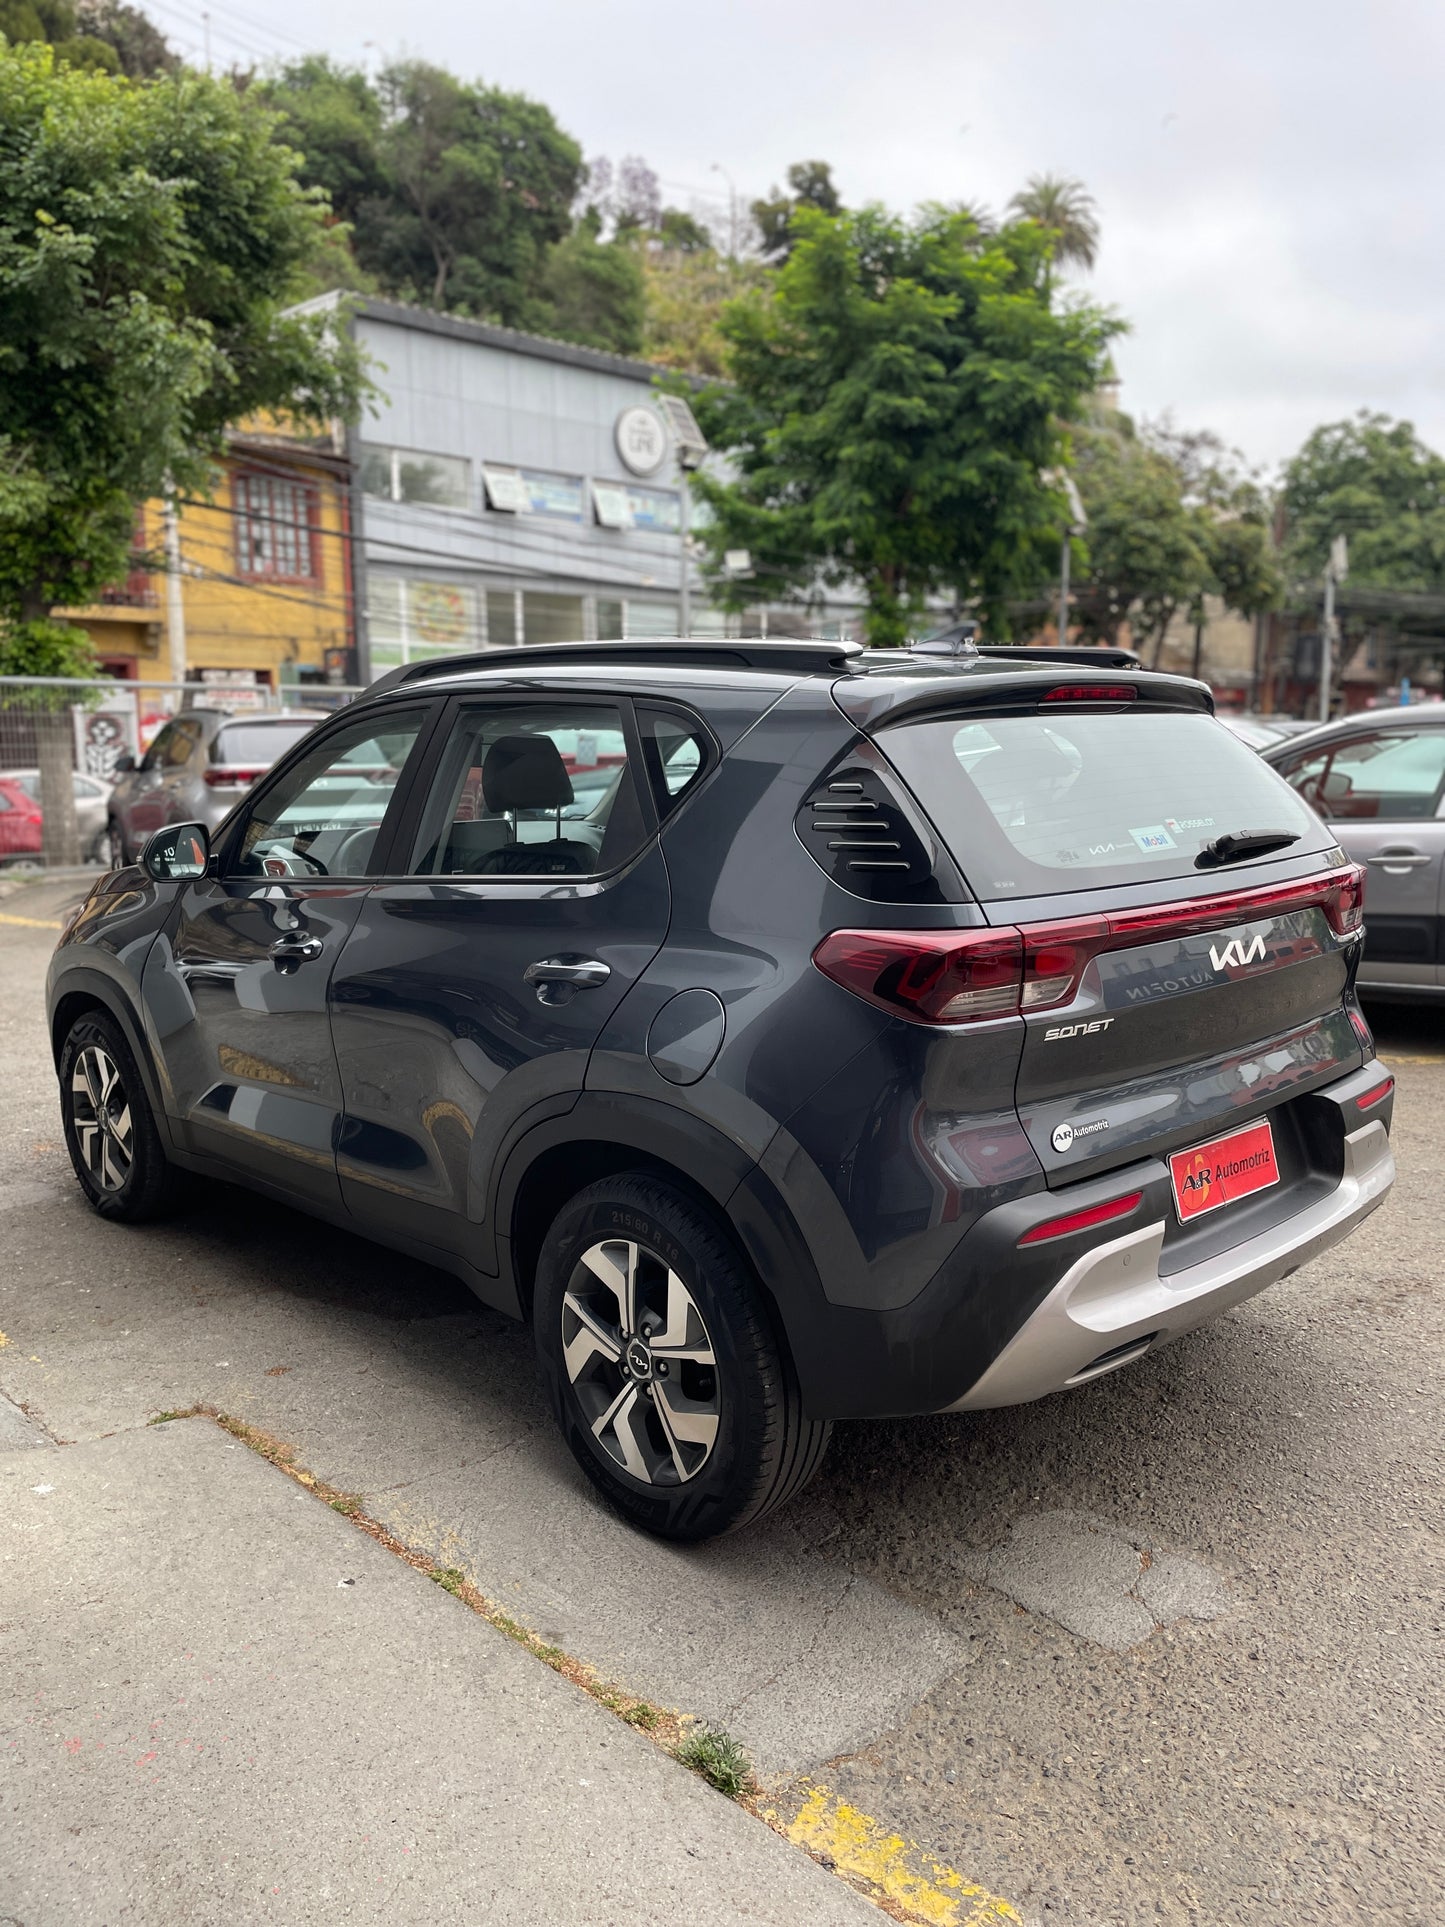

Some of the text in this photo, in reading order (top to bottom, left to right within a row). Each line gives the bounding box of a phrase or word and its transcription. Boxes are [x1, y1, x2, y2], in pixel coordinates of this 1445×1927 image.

[1140, 833, 1169, 848] Mobil
[1208, 934, 1267, 972] KIA
[1044, 1018, 1115, 1042] SONET
[1054, 1120, 1109, 1143] AR Automotriz
[1181, 1168, 1213, 1195] A&R
[1215, 1148, 1271, 1182] Automotriz
[611, 1210, 649, 1234] 215/60
[666, 1242, 679, 1261] 16
